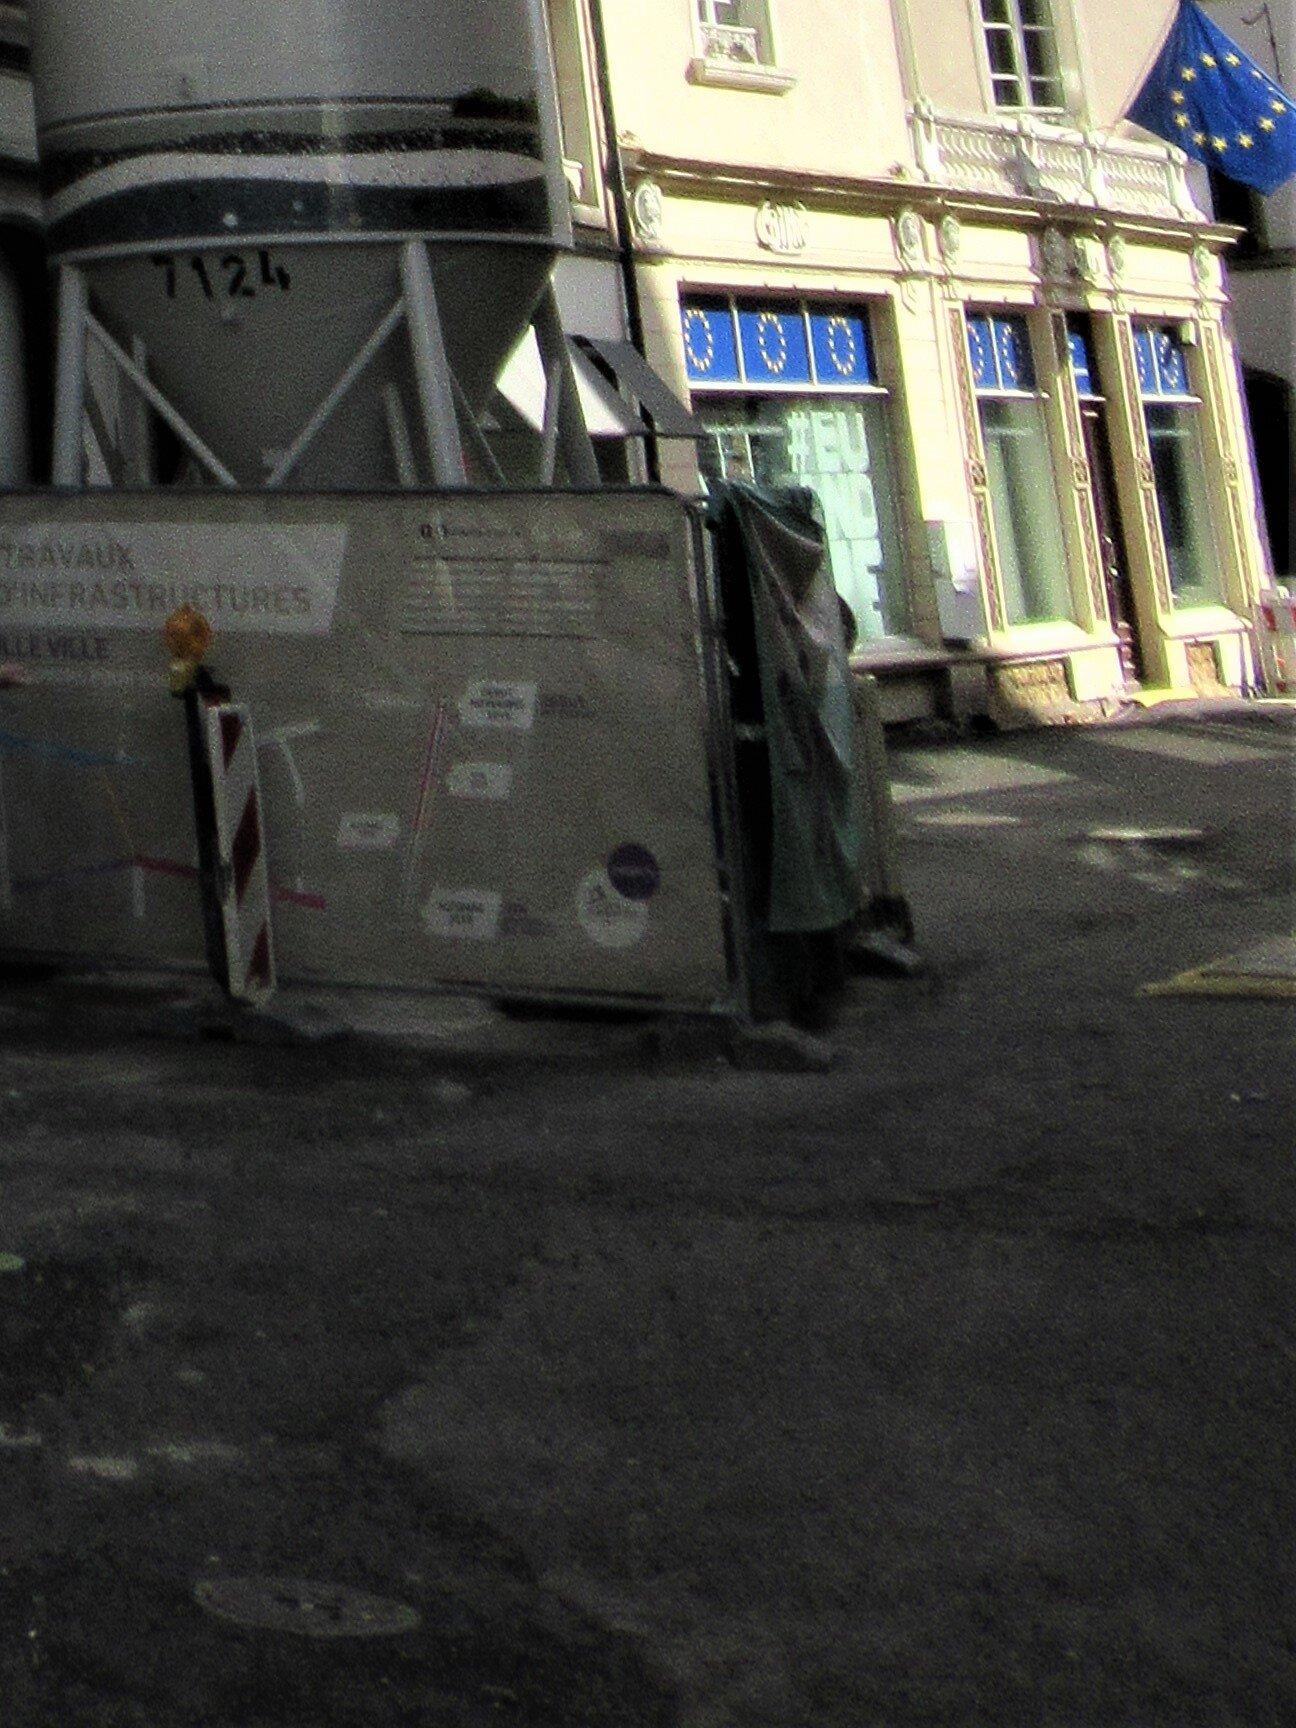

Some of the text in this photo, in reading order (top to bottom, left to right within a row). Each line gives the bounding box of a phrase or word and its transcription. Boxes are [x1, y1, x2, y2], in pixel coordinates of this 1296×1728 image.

[151, 250, 291, 301] 7124
[787, 410, 871, 474] #EU
[49, 635, 110, 662] VILLE
